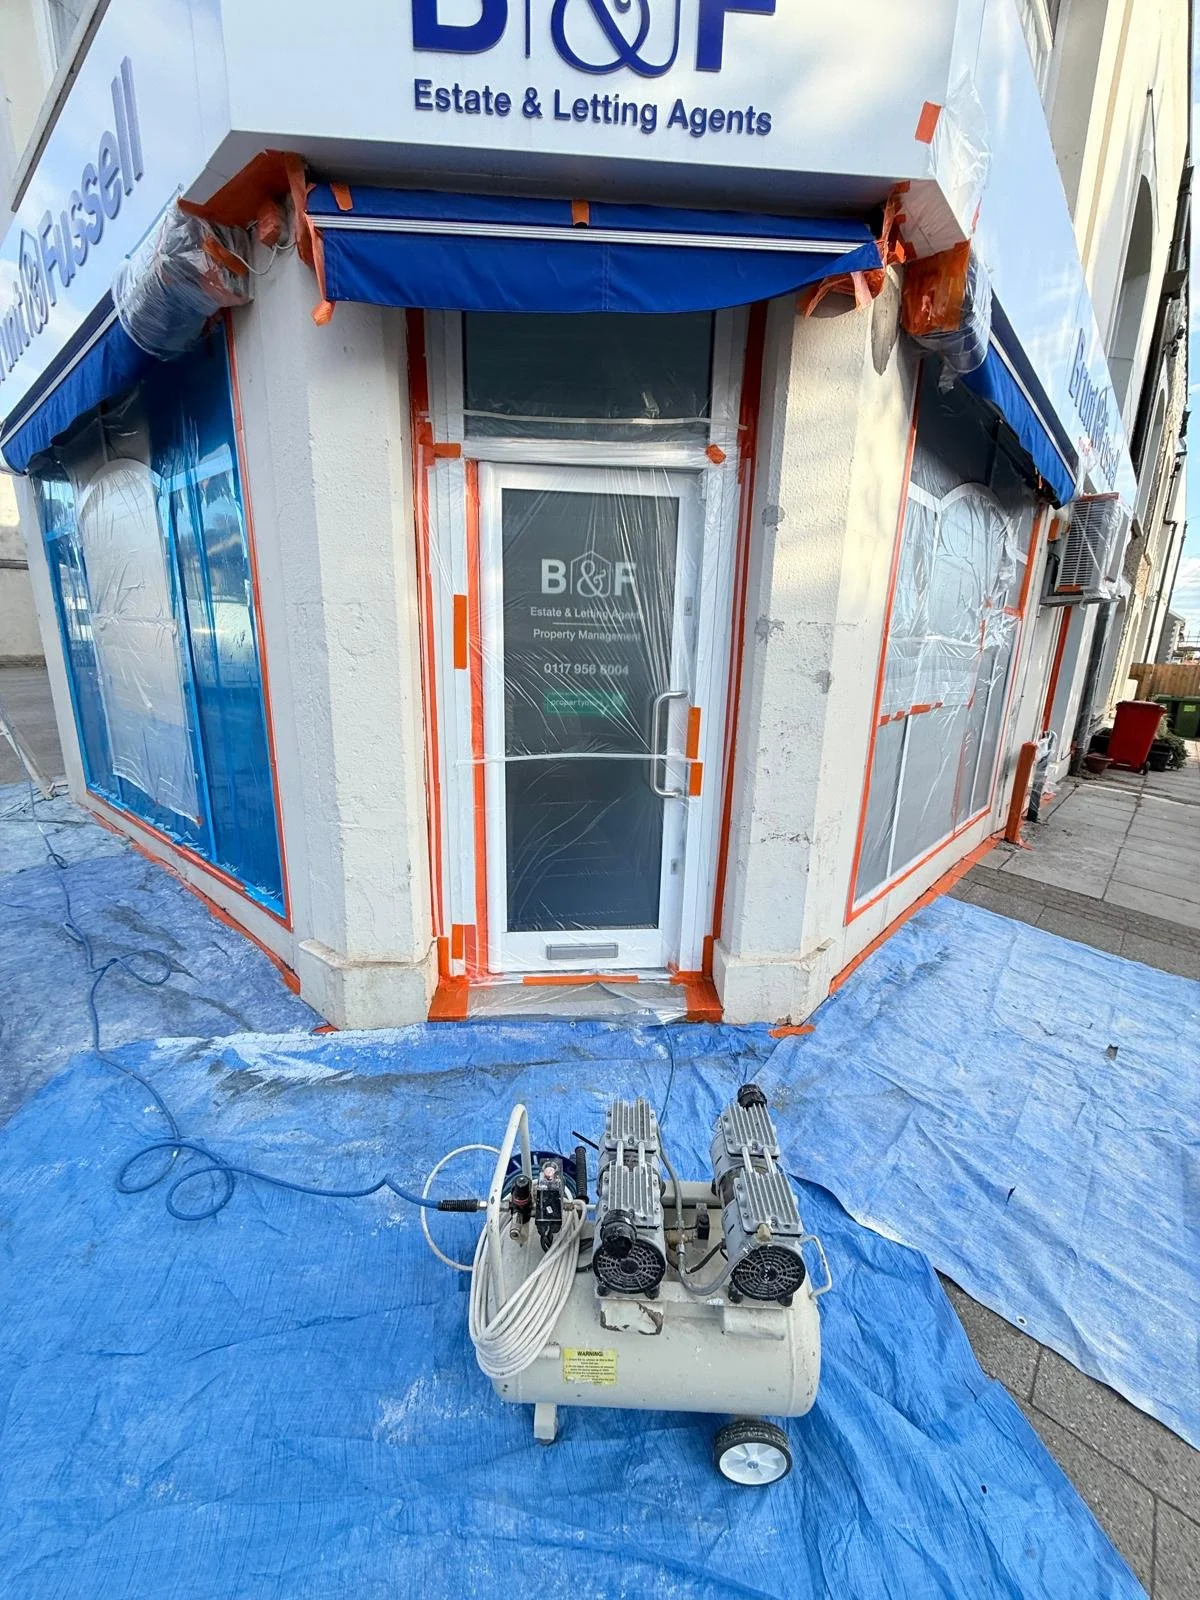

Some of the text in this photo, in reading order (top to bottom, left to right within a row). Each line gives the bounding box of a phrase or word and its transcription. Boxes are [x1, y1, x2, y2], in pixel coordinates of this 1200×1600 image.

[414, 78, 773, 137] Estate & Letting Agents
[37, 55, 144, 308] Fussell
[530, 607, 562, 617] Estate
[564, 608, 572, 617] &
[533, 628, 641, 643] Property Management
[543, 663, 571, 674] 0117
[573, 664, 597, 675] 956
